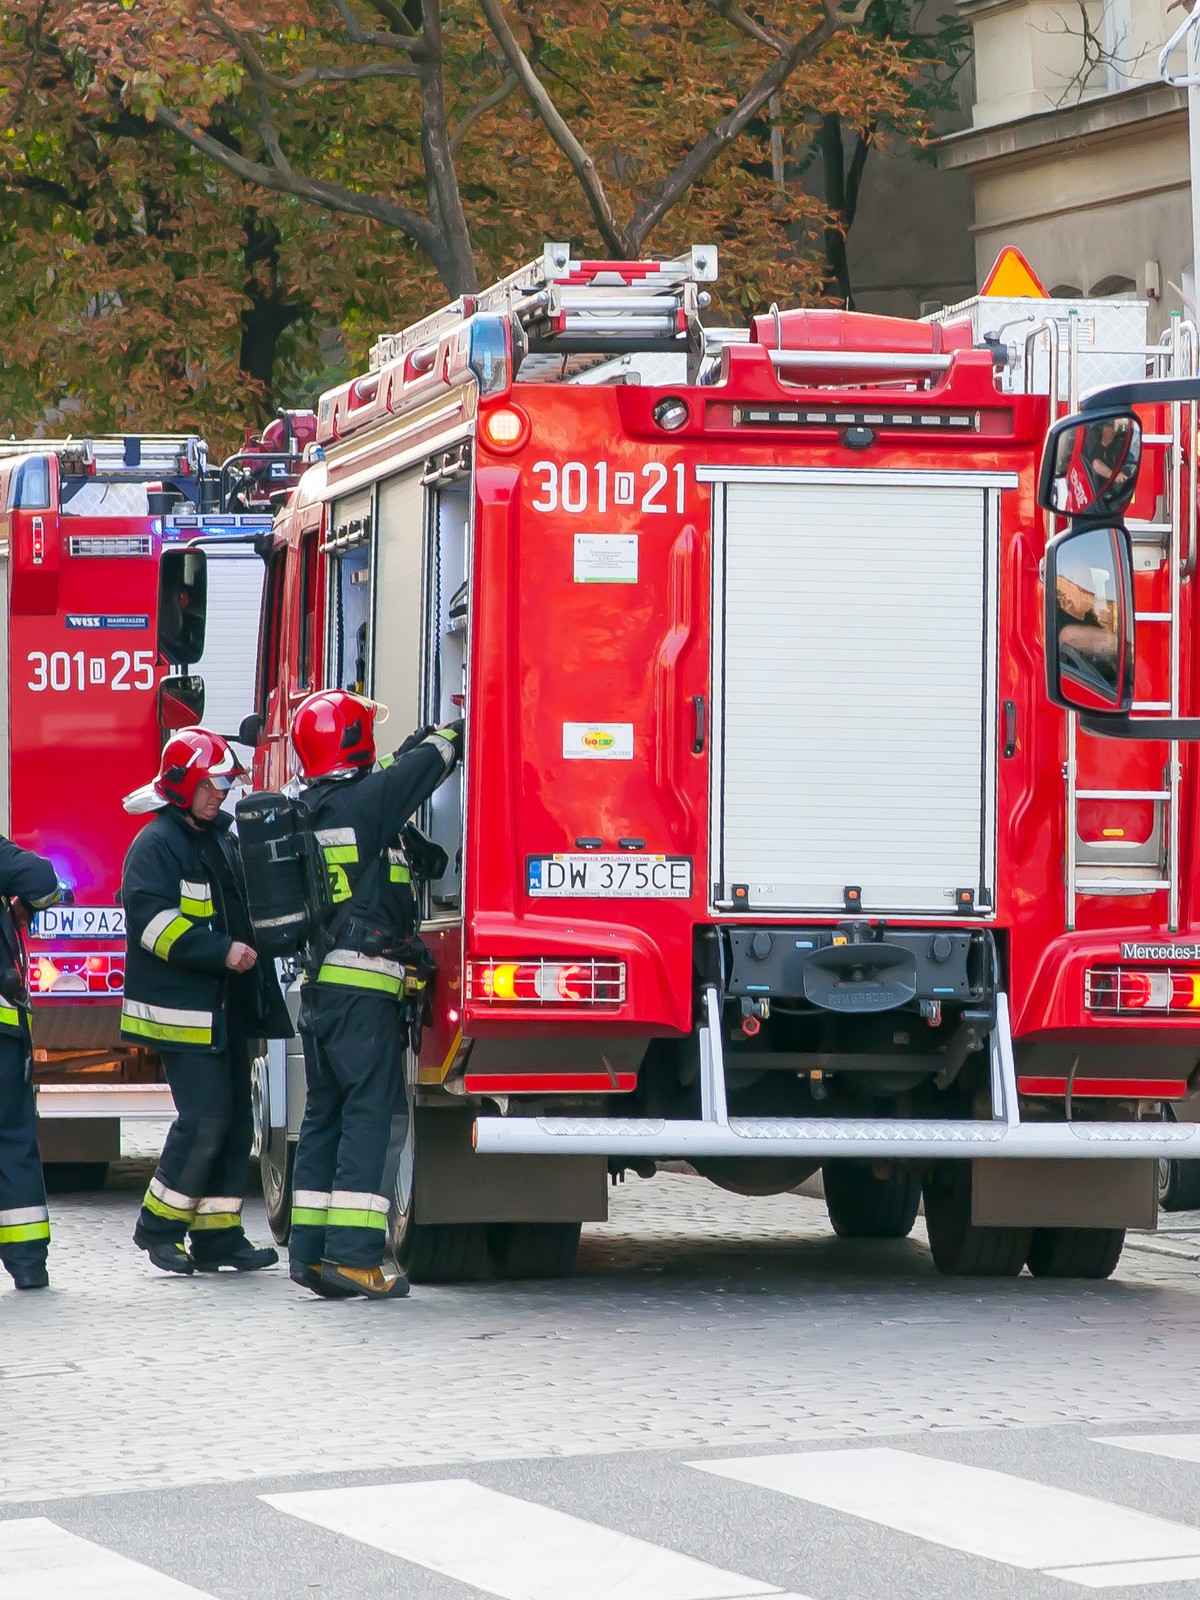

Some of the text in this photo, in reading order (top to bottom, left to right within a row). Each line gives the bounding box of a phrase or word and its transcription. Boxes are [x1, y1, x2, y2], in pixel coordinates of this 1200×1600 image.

[69, 617, 100, 627] WISS
[530, 878, 541, 888] PL
[548, 862, 686, 889] DW 375CE
[44, 911, 75, 931] DW
